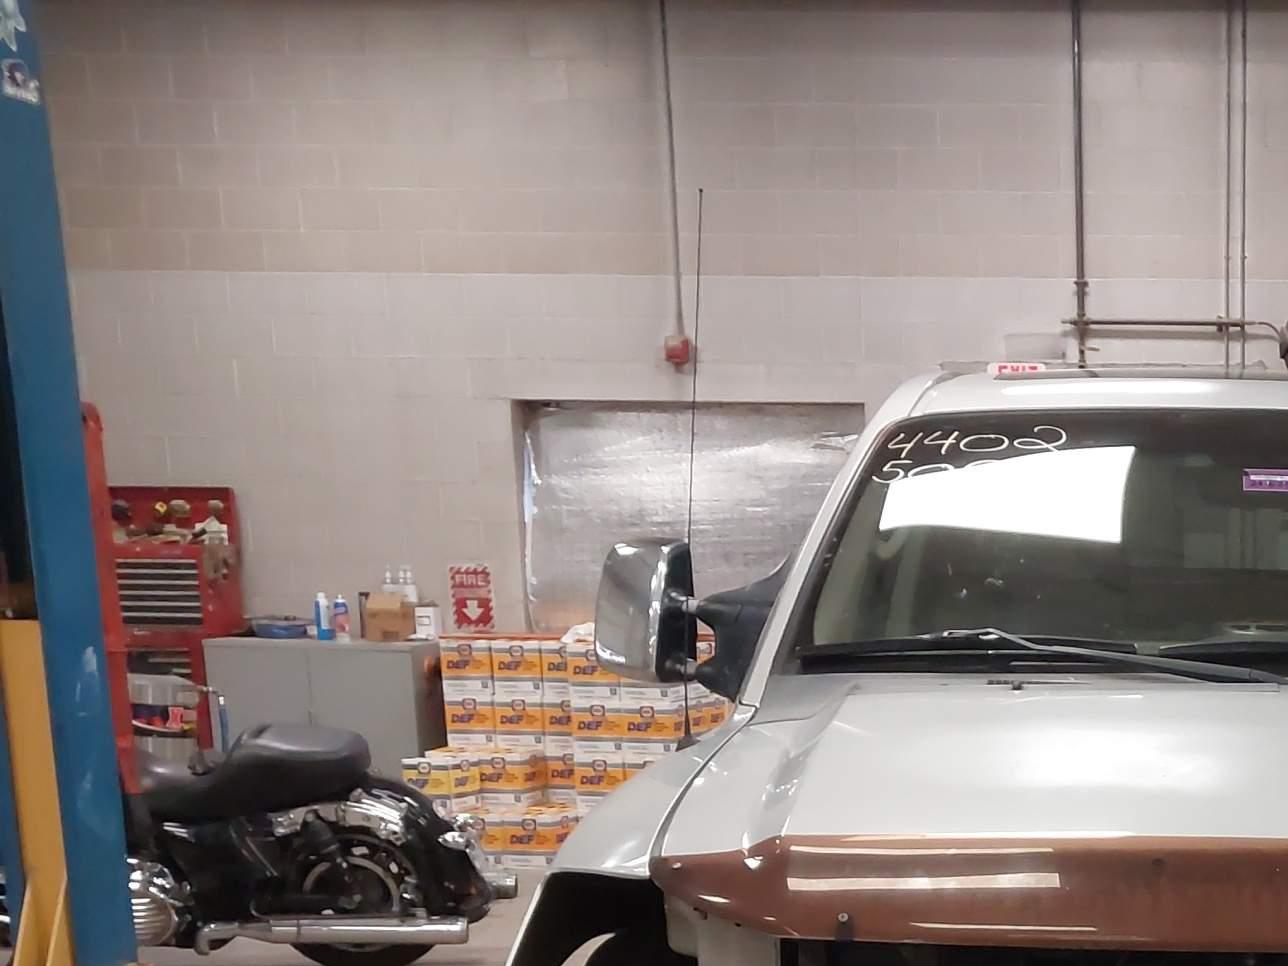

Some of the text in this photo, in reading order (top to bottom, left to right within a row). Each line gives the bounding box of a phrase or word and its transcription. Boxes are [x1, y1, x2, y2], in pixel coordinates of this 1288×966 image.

[888, 425, 1068, 458] 4402
[577, 721, 603, 731] DEF
[627, 721, 652, 731] DEF
[580, 775, 605, 785] DEF
